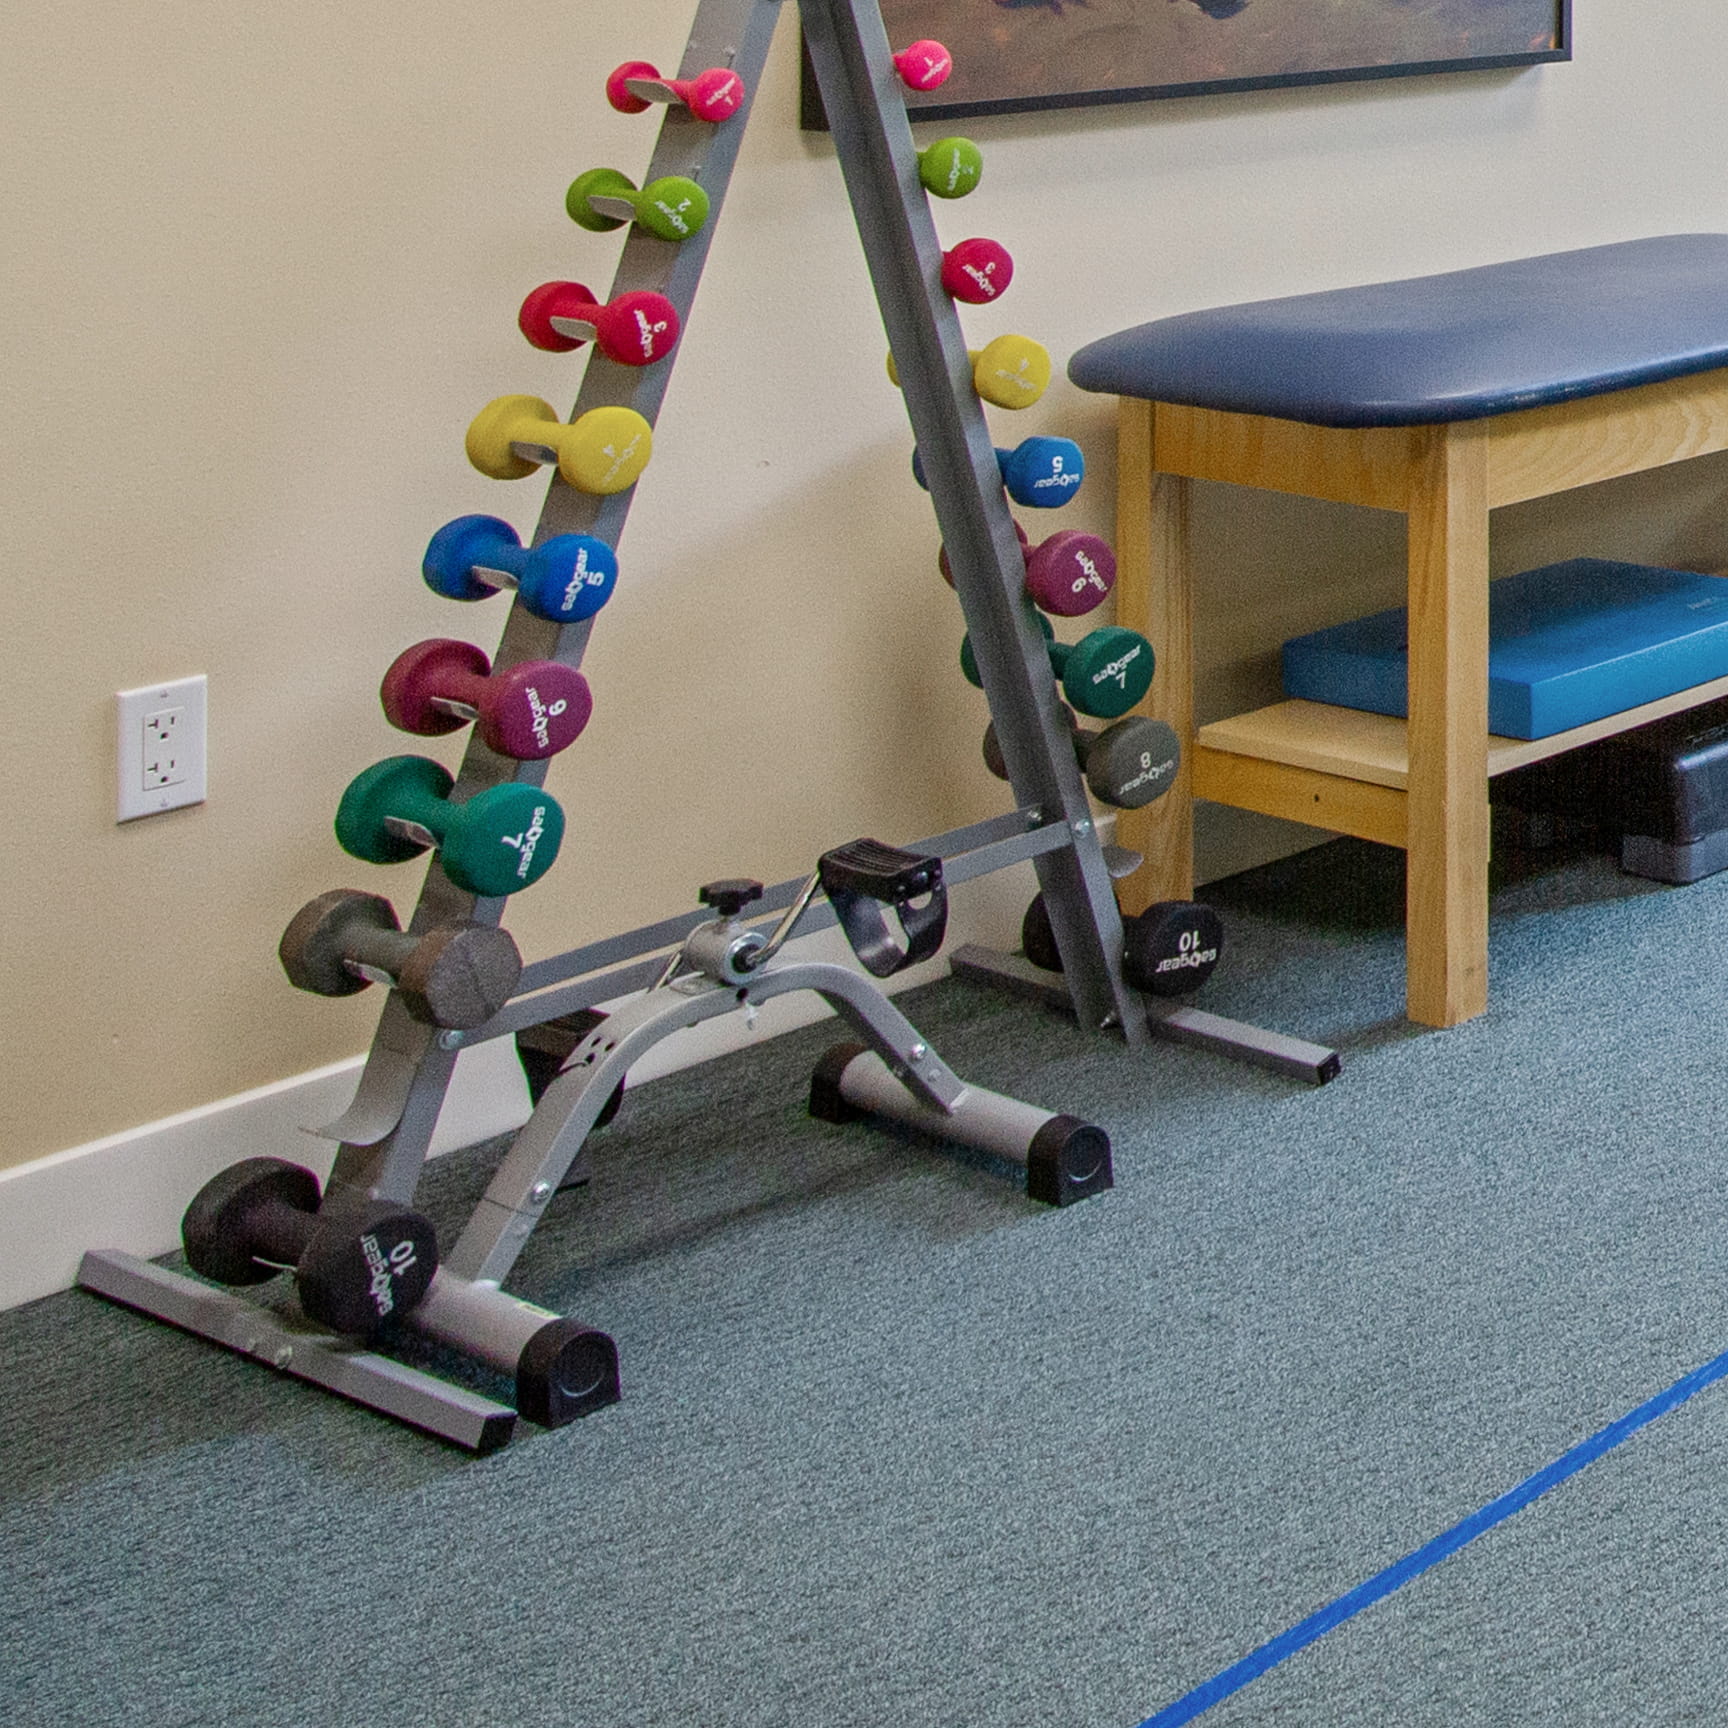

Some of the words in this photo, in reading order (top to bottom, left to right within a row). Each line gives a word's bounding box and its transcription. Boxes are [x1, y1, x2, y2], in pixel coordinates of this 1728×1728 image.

[678, 197, 692, 212] 2
[984, 262, 996, 275] 3
[653, 320, 667, 333] 3
[1052, 455, 1064, 473] 5
[586, 571, 605, 587] 5
[1071, 577, 1087, 593] 6
[1115, 670, 1127, 689] 7
[548, 698, 567, 716] 6
[1140, 751, 1151, 769] 8
[501, 832, 524, 849] 7
[1179, 929, 1200, 952] 10
[389, 1239, 417, 1276] 10
